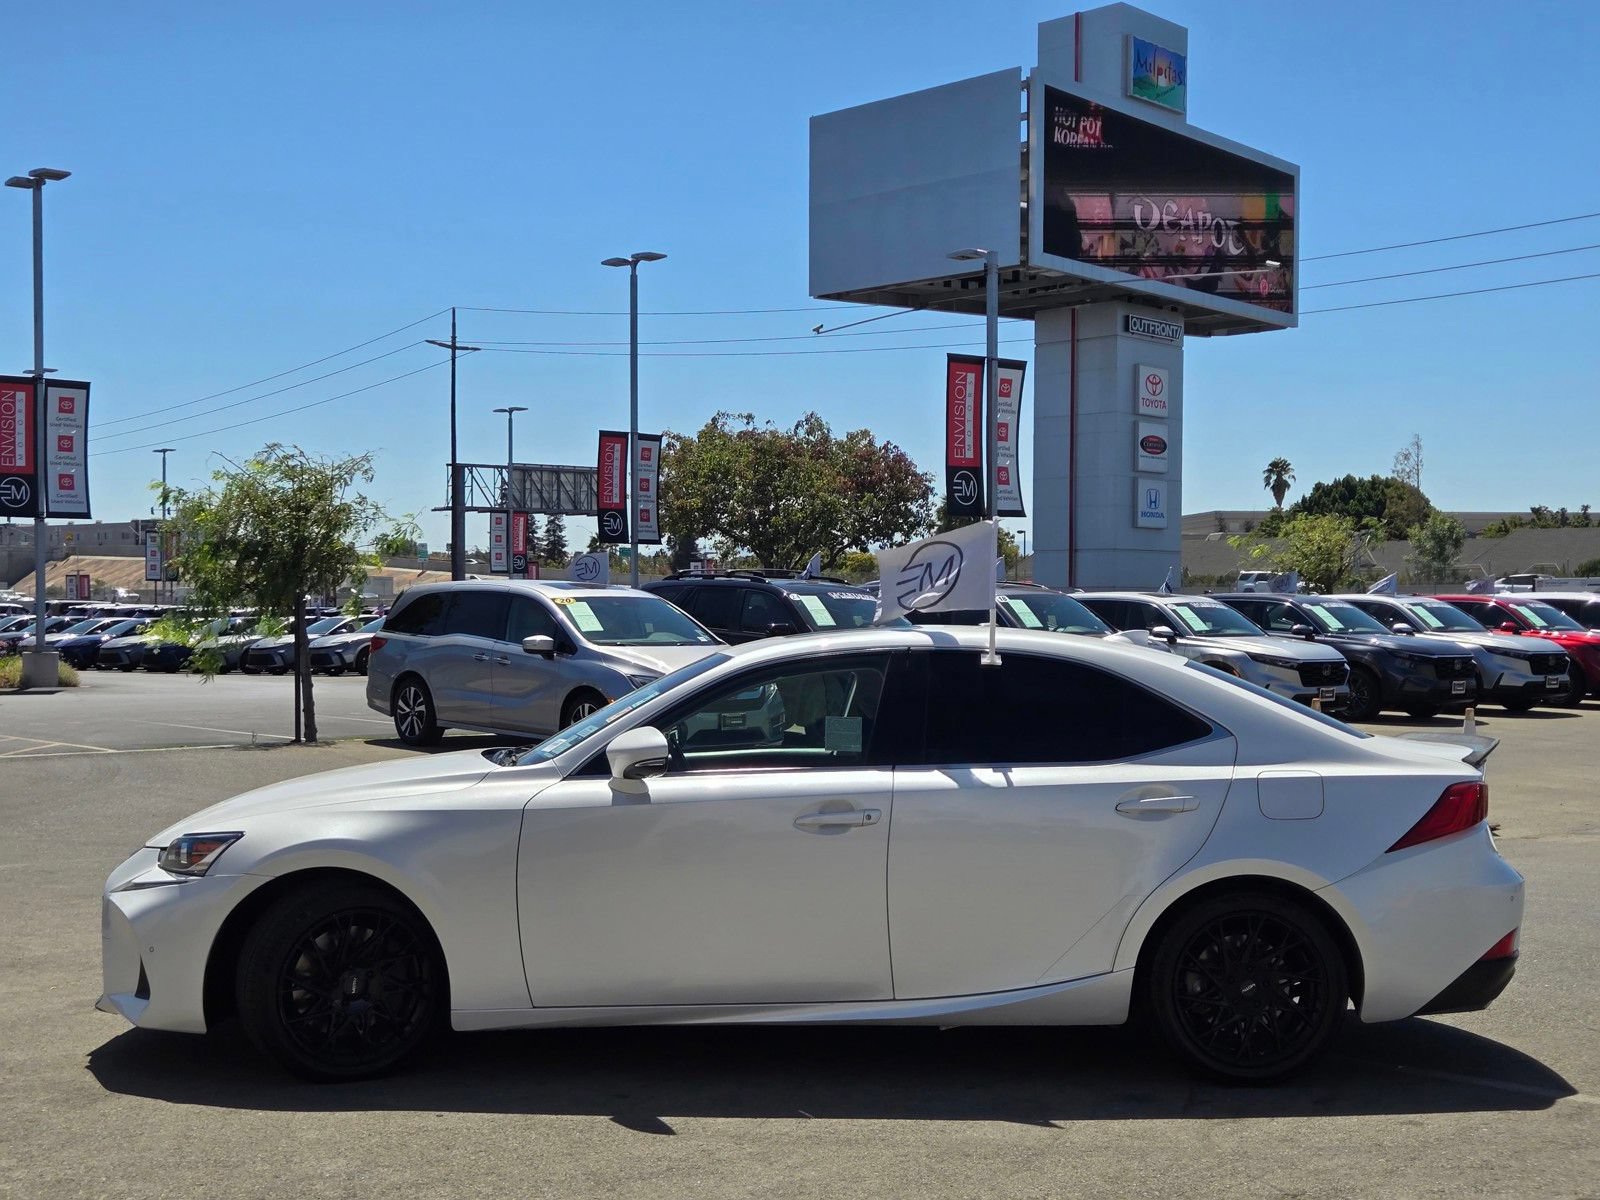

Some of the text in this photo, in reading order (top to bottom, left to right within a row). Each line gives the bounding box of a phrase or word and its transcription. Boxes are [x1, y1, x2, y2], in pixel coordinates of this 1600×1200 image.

[1134, 47, 1183, 88] Milpitas
[1, 390, 15, 466] ENVISION
[953, 372, 966, 458] ENVISION
[1141, 397, 1166, 410] TOYOTA
[604, 443, 614, 503] ENVISION
[1141, 511, 1165, 519] HONDA
